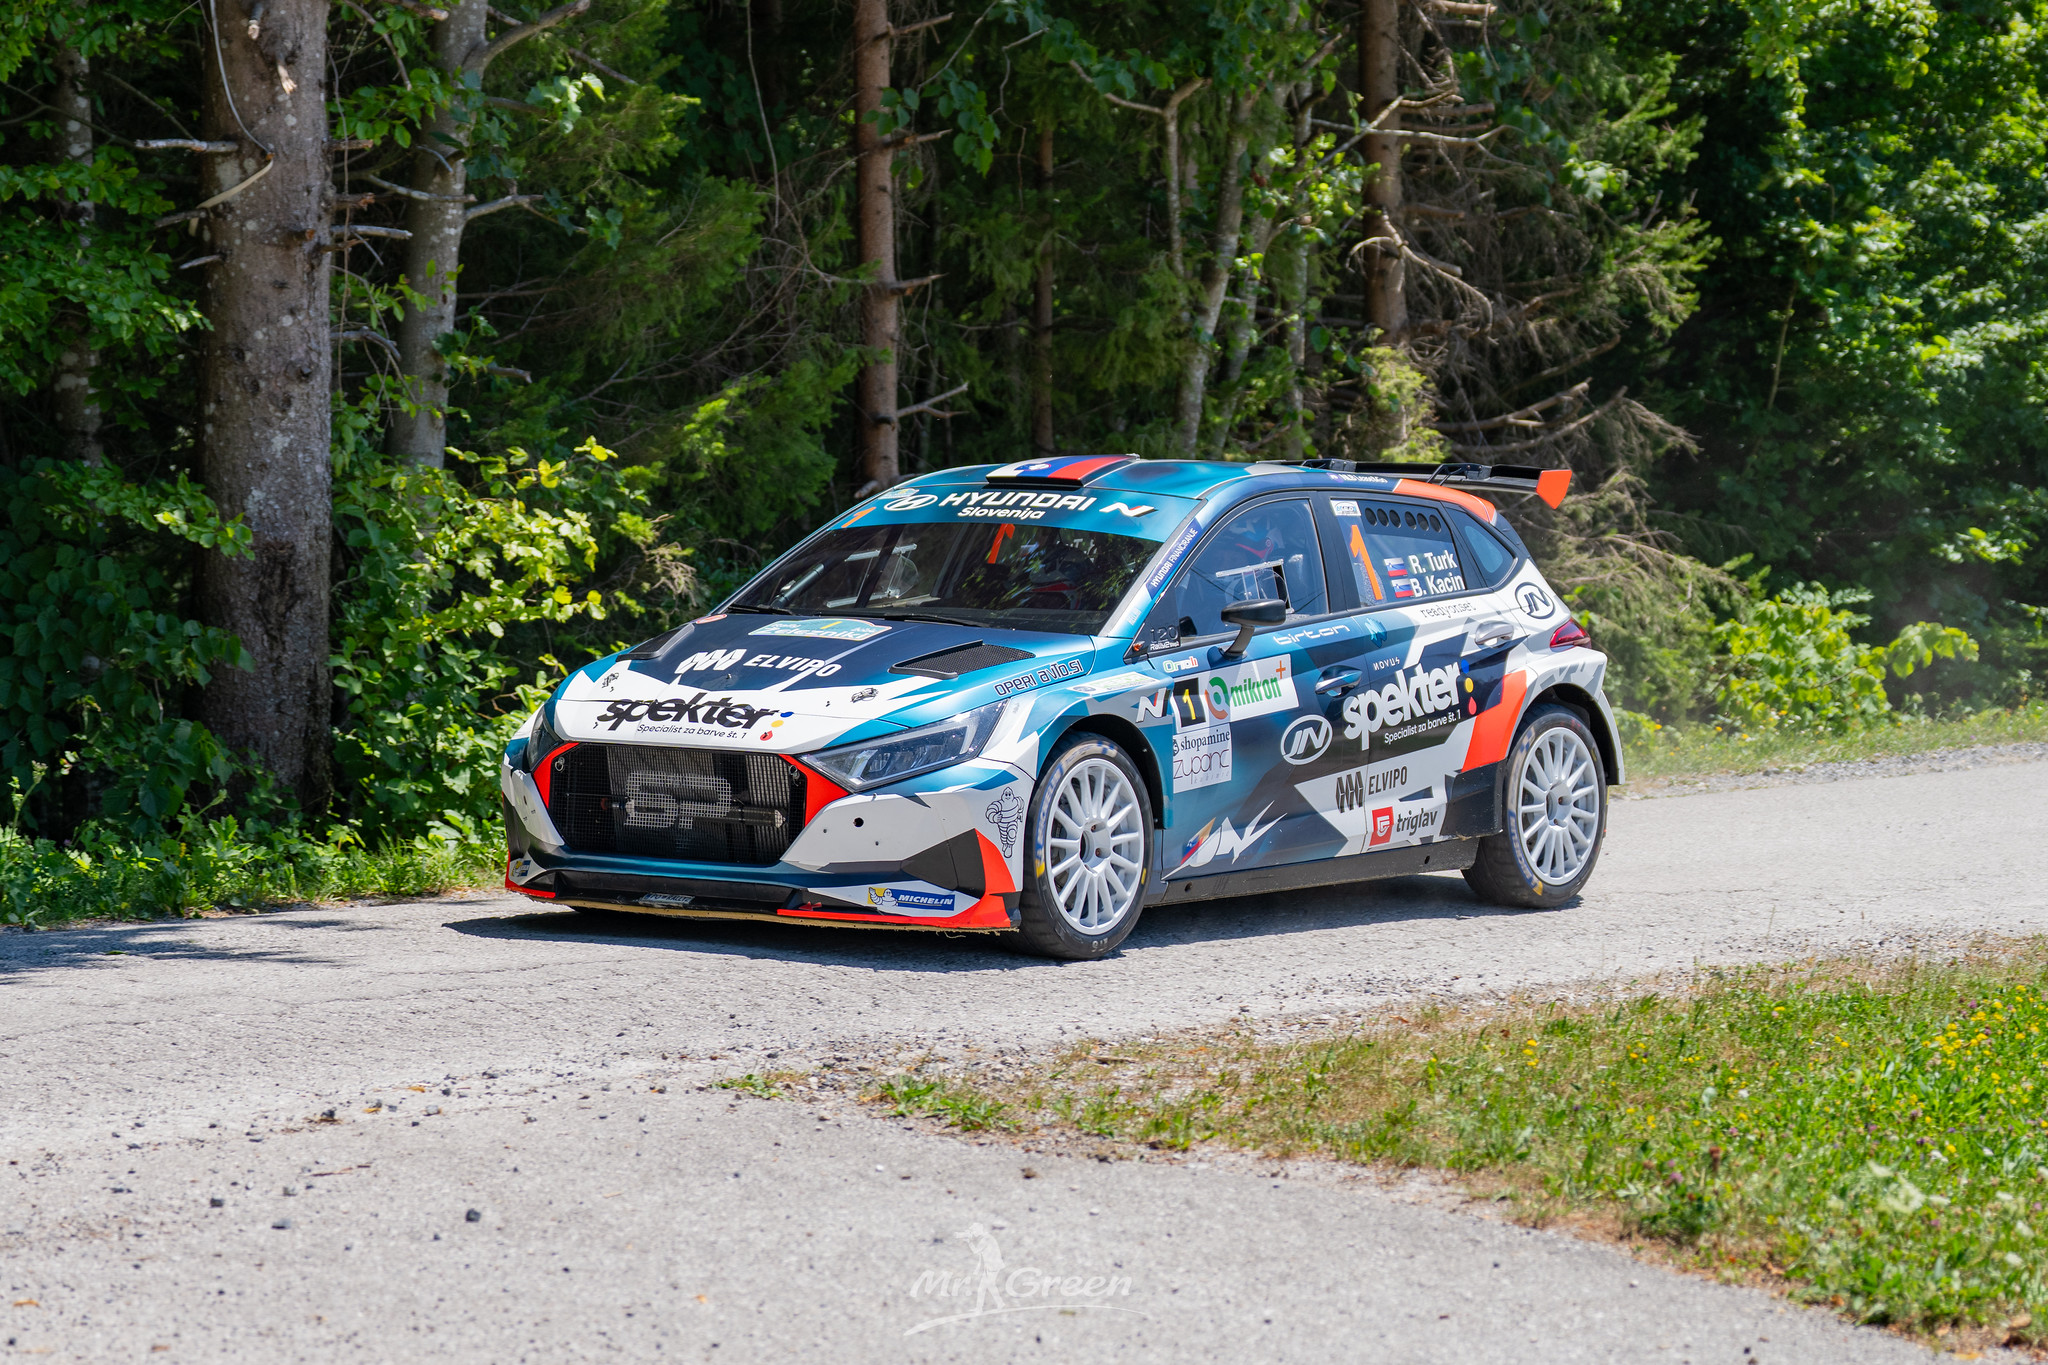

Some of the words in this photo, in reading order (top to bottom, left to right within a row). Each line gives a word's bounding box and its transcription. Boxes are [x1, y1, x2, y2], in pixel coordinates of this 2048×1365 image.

[938, 491, 1098, 511] HYUNDAI
[958, 506, 1046, 520] Slovenija
[1150, 560, 1174, 588] HYUNDAI
[1350, 524, 1384, 600] 1
[1408, 554, 1426, 575] R.
[1423, 549, 1458, 572] Turk
[1409, 577, 1428, 598] B.
[1425, 571, 1466, 595] Kacin
[1273, 624, 1351, 645] birton
[743, 654, 842, 677] ELVIPO
[1372, 656, 1400, 671] NOVUS
[596, 692, 780, 731] spekter
[1181, 688, 1197, 720] 1
[1343, 661, 1461, 751] spekter
[637, 723, 682, 734] Specialist
[683, 727, 696, 735] za
[694, 727, 726, 738] barve
[1180, 729, 1231, 751] shopamine
[1384, 724, 1418, 745] Specialist
[1417, 723, 1427, 733] za
[1427, 717, 1448, 730] barve
[1368, 765, 1408, 795] ELVIPO
[1396, 807, 1438, 836] triglav
[898, 894, 954, 905] MICHELIN
